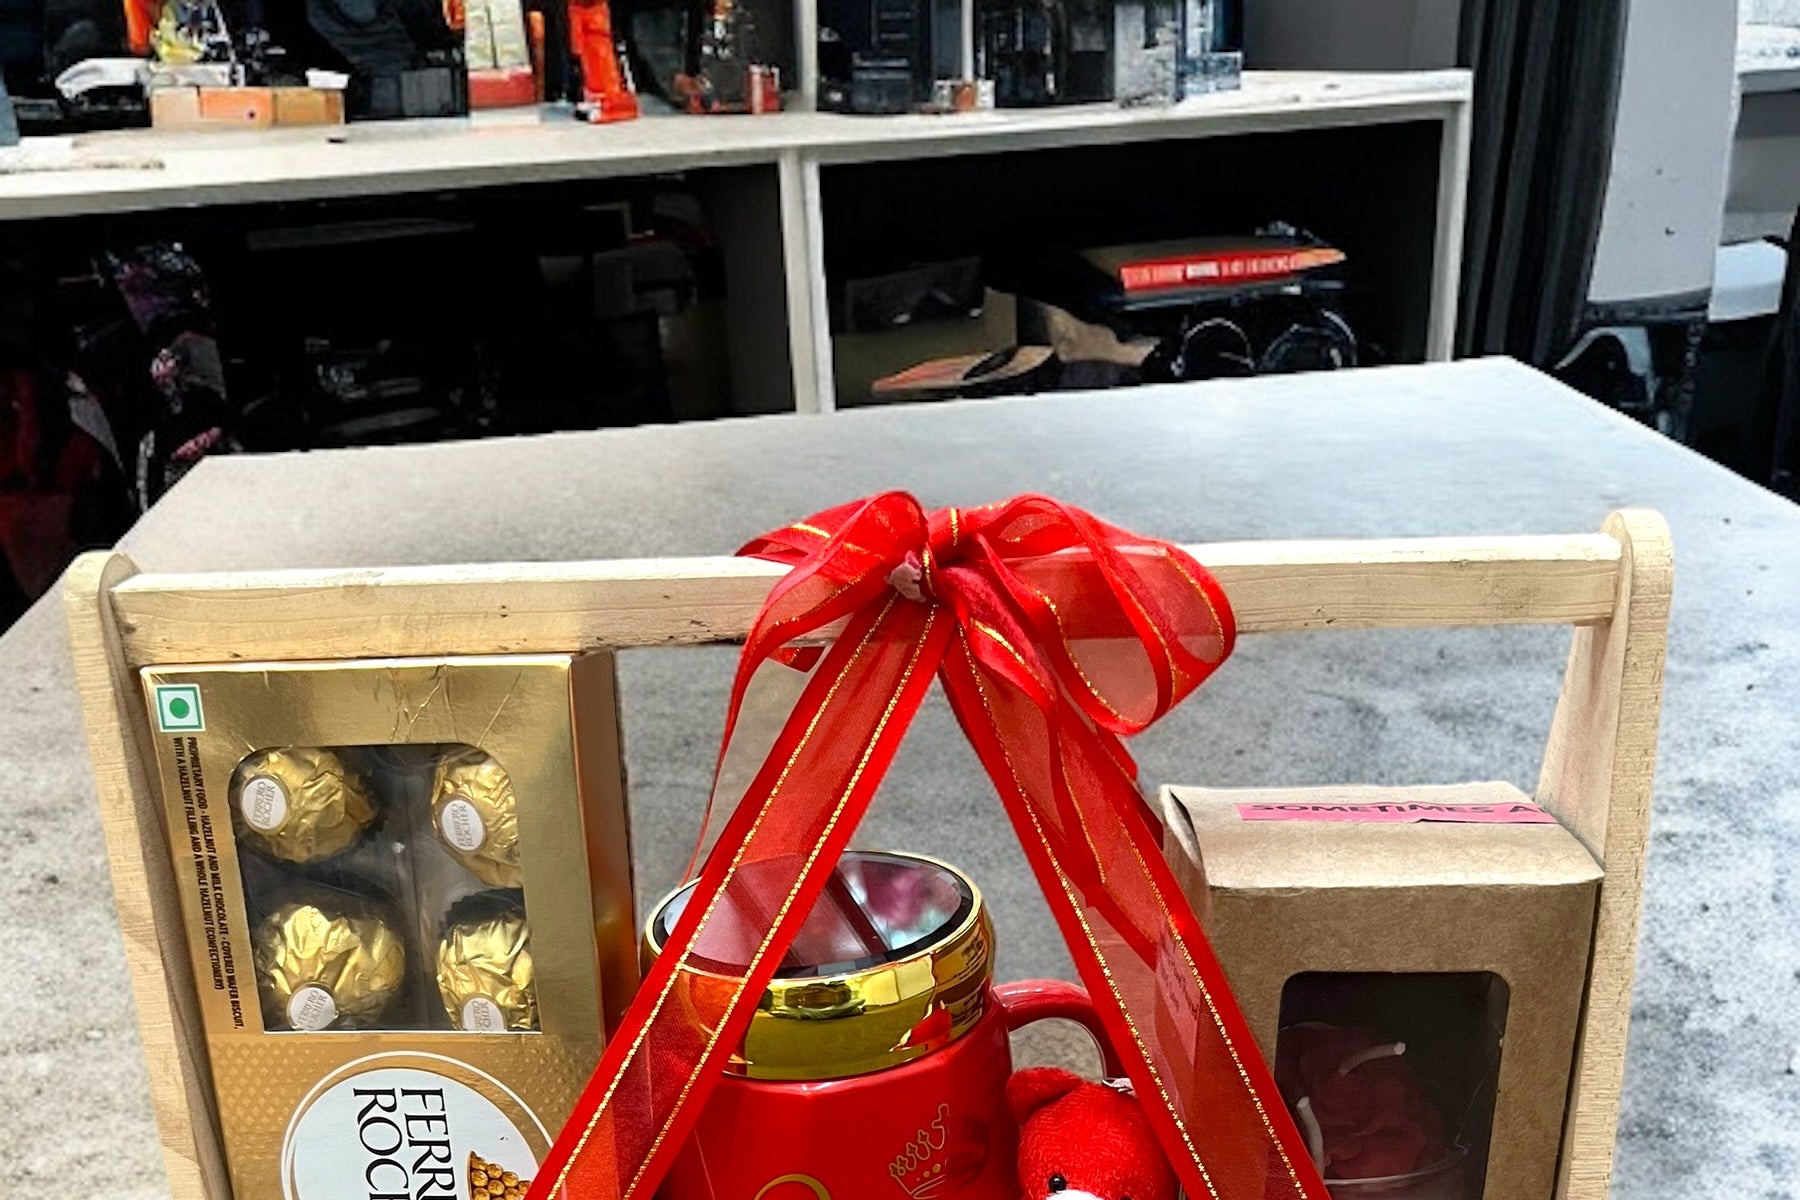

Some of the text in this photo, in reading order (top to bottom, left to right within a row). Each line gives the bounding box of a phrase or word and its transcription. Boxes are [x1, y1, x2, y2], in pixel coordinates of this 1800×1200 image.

[173, 736, 185, 758] WITH
[176, 758, 186, 766] A
[187, 736, 205, 790] PROPRIETARY
[178, 766, 194, 805] HAZELNUT
[195, 790, 208, 810] FOOD
[252, 781, 267, 823] FERRERO
[185, 805, 199, 835] FILLING
[260, 785, 276, 826] ROCHER
[1252, 804, 1495, 813] SOMETIMES
[201, 815, 217, 854] HAZELNUT
[451, 803, 466, 846] FERRERO
[459, 804, 474, 847] ROCHER
[190, 835, 202, 852] AND
[195, 860, 208, 886] WHOLE
[208, 855, 220, 872] AND
[211, 872, 222, 891] MILK
[200, 887, 215, 926] HAZELNUT
[213, 892, 230, 935] CHOCOLATE
[205, 926, 225, 991] (CONFECTIONERY)
[221, 941, 236, 974] COVERED
[226, 975, 239, 999] WAFER
